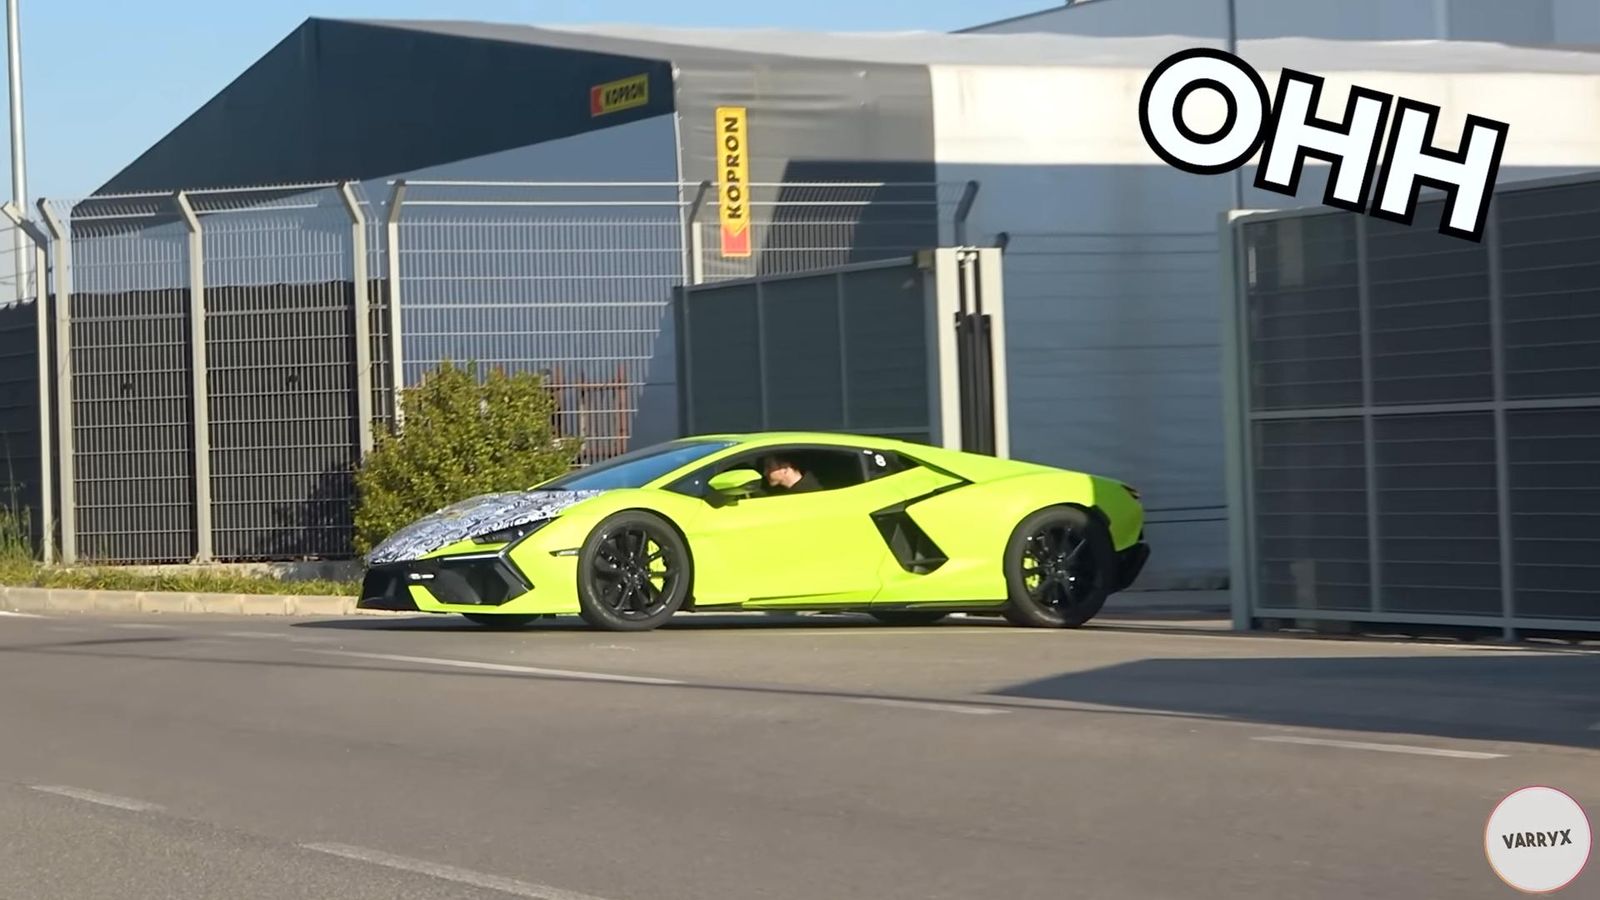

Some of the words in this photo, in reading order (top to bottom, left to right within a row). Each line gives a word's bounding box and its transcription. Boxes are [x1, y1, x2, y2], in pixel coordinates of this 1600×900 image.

[605, 80, 646, 107] KOPRON
[724, 116, 742, 219] KOPRON
[874, 454, 886, 467] 8
